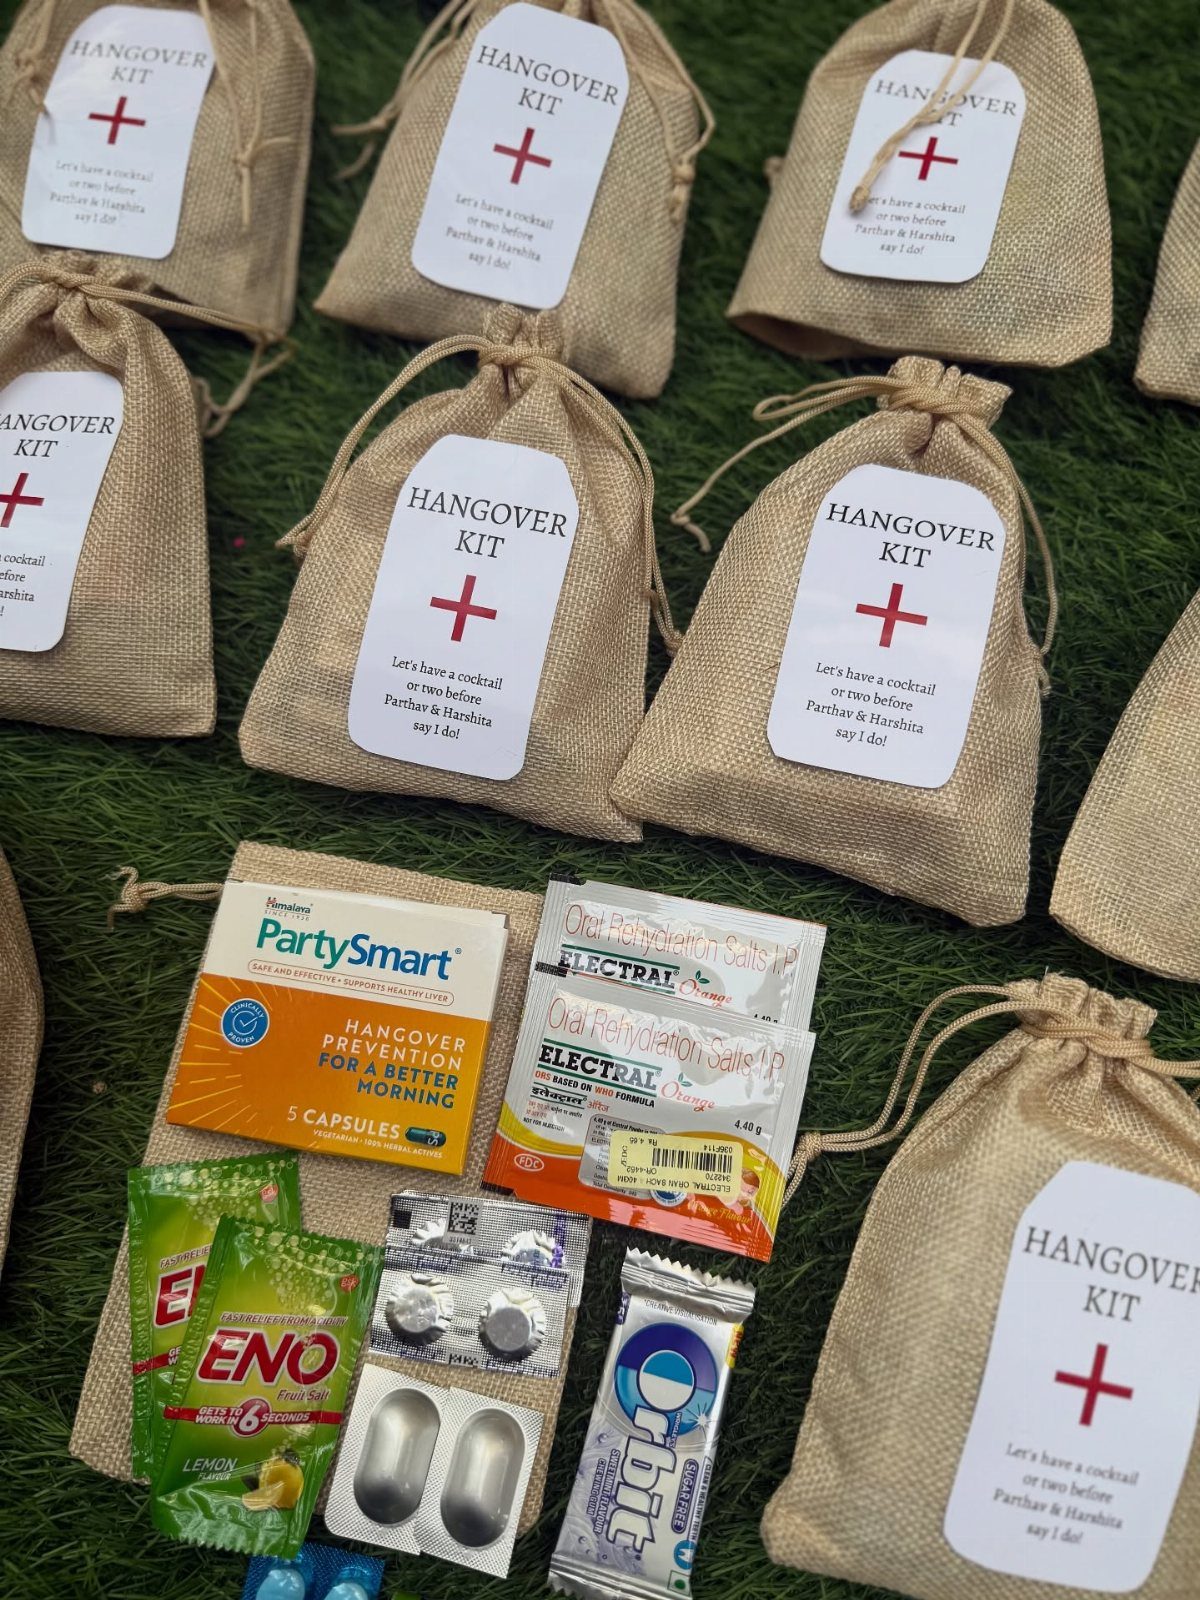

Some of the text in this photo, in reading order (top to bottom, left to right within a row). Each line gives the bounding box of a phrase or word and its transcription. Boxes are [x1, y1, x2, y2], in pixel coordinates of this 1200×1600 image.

[70, 40, 208, 69] HANGOVER
[111, 66, 153, 84] KIT
[477, 45, 619, 105] HANGOVER
[518, 87, 563, 116] KIT
[889, 197, 967, 214] have cocktail
[889, 213, 910, 223] two
[912, 214, 947, 227] before
[880, 242, 924, 255] say do!
[909, 230, 955, 243] Harshita
[0, 413, 115, 435] ANGOVER
[13, 438, 58, 457] KIT
[407, 486, 568, 538] HANGOVER
[826, 502, 995, 552] HANGOVER
[454, 530, 505, 559] KIT
[878, 542, 931, 568] KIT
[3, 553, 46, 567] cocktail
[392, 655, 503, 691] Let's have a cocktail
[815, 662, 936, 696] Let's have a cocktail
[406, 680, 482, 705] or two before
[831, 685, 914, 712] or two before
[384, 693, 492, 728] Parthav & Harshita
[805, 699, 924, 734] Parthav & Harshita
[413, 720, 461, 740] say I do!
[835, 727, 888, 747] say I do!
[265, 896, 312, 915] Himalaya
[565, 903, 769, 973] Oral Rehydration Salts
[252, 963, 449, 1003] SAFE AND EFFECTIVE SUPPORTS HEALTHY LIVER
[557, 949, 676, 990] ELECTRAL
[679, 977, 733, 1009] Orange
[230, 1002, 265, 1018] CLINICALLY
[227, 1032, 255, 1044] PROVEN
[345, 1018, 467, 1053] HANGOVER
[548, 997, 755, 1078] Oral Rehydration Salts
[322, 1034, 463, 1072] PREVENTION
[538, 1044, 658, 1091] ELECTRAL
[318, 1052, 459, 1091] FOR A BETTER
[356, 1078, 455, 1110] MORNING
[534, 1069, 656, 1109] ORS BASED ON WHO FORMULA
[661, 1080, 716, 1113] Orange
[287, 1105, 401, 1140] 5 CAPSULES
[734, 1119, 763, 1135] 4.40 g
[313, 1129, 444, 1160] VEGETARIAN 100% HERBAL ACTIVES
[518, 1155, 541, 1171] FDC
[645, 1177, 731, 1193] ELECTRAL ORAN SACH
[1083, 1285, 1141, 1322] KIT
[221, 1313, 244, 1324] FAST
[244, 1313, 280, 1325] RELIEF
[281, 1315, 310, 1326] FROM
[198, 1328, 340, 1386] ENO
[277, 1389, 330, 1401] Fruit Salt
[195, 1415, 240, 1426] WORK IN
[199, 1406, 243, 1417] GETS TO
[238, 1404, 260, 1432] 6
[260, 1413, 310, 1423] SECONDS
[606, 1321, 718, 1554] Orbit
[183, 1457, 238, 1473] LEMON
[198, 1472, 231, 1481] FLAVOUR
[1005, 1442, 1139, 1487] Let's have a cocktail
[586, 1458, 607, 1516] CHEWING GUM
[593, 1449, 621, 1533] SWEETMINT FLAVOUR
[674, 1463, 697, 1530] SUGAR FREE
[1022, 1472, 1113, 1505] or two before
[690, 1464, 713, 1541] CLEAN HEALTHY TEETH
[993, 1488, 1123, 1531] Parthav & Harshita
[1026, 1523, 1083, 1546] say I do!
